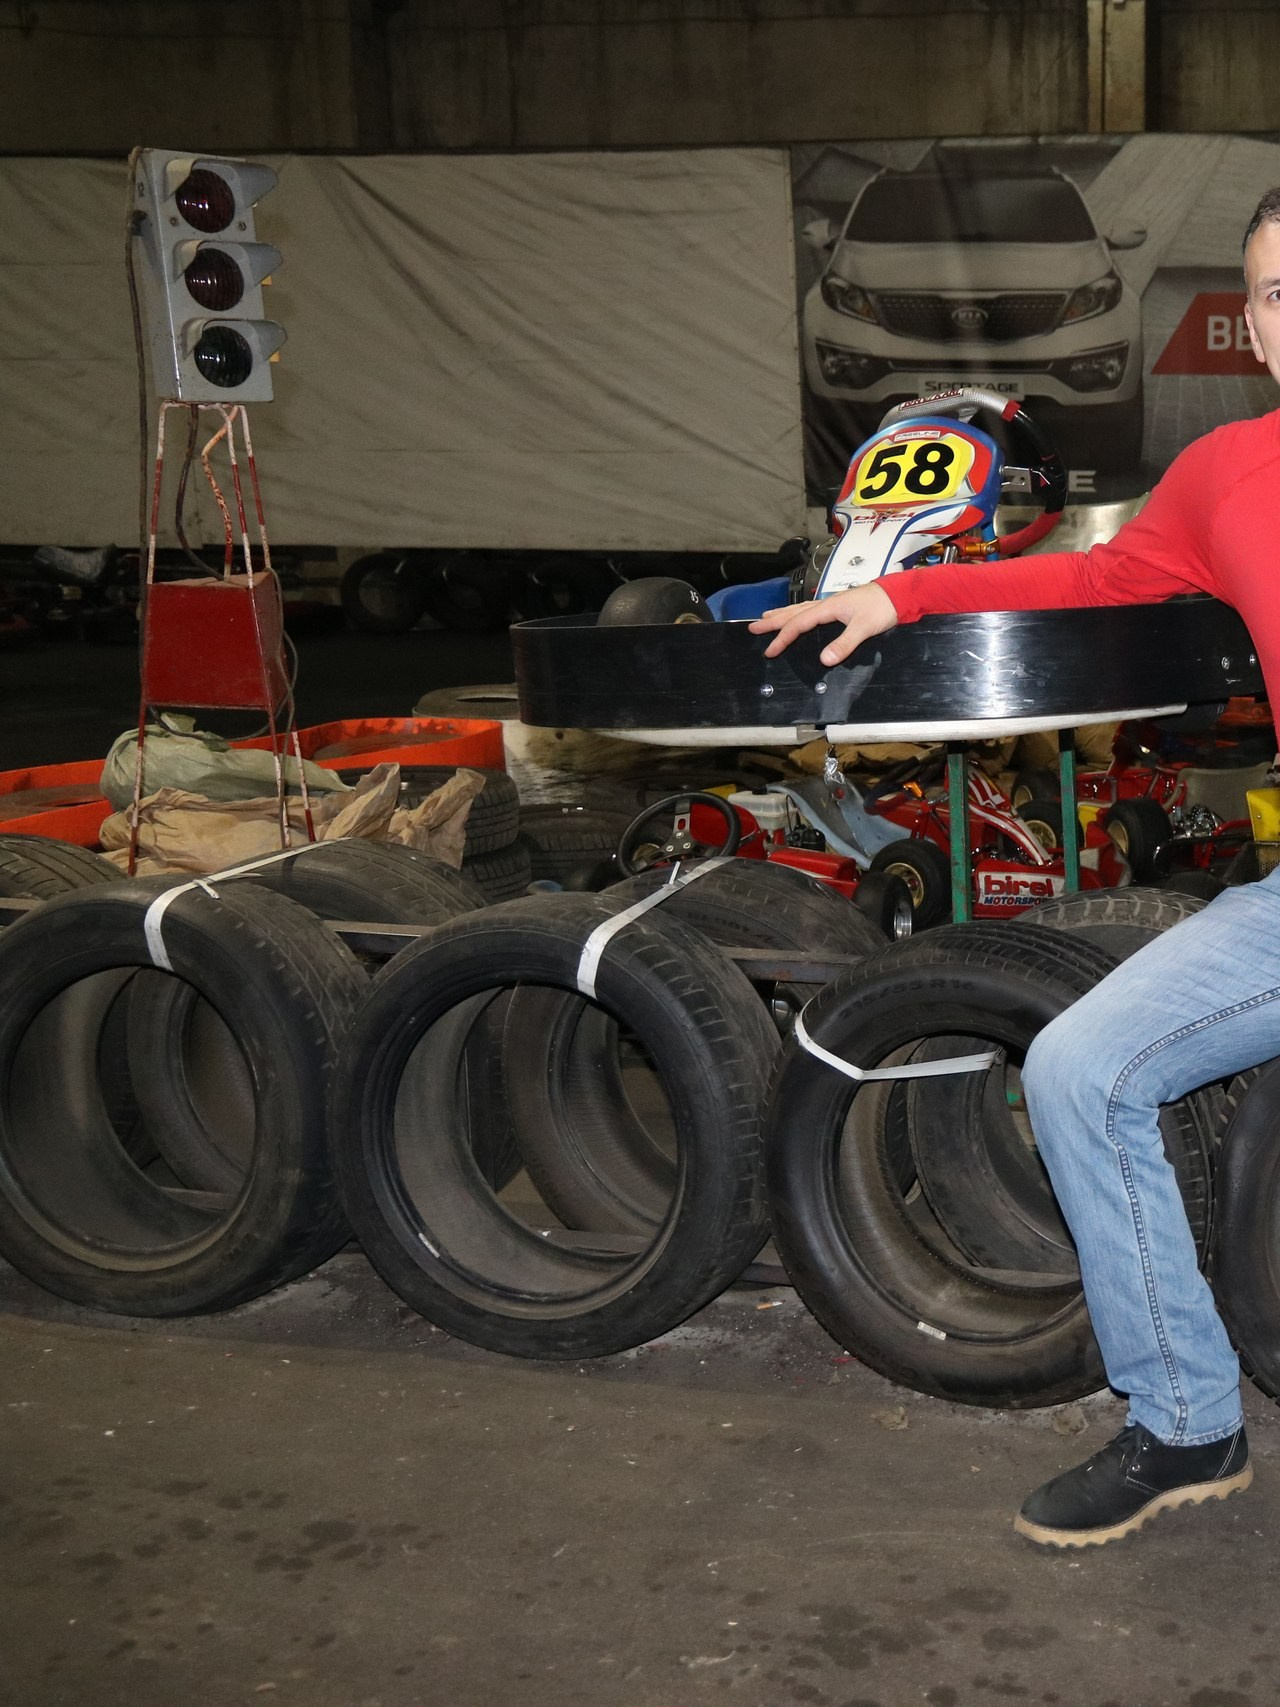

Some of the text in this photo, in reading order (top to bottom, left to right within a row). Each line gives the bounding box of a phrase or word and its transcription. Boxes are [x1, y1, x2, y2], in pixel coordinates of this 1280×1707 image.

[859, 442, 955, 500] 58
[984, 875, 1054, 897] birel
[984, 896, 1052, 906] MOTORSPO
